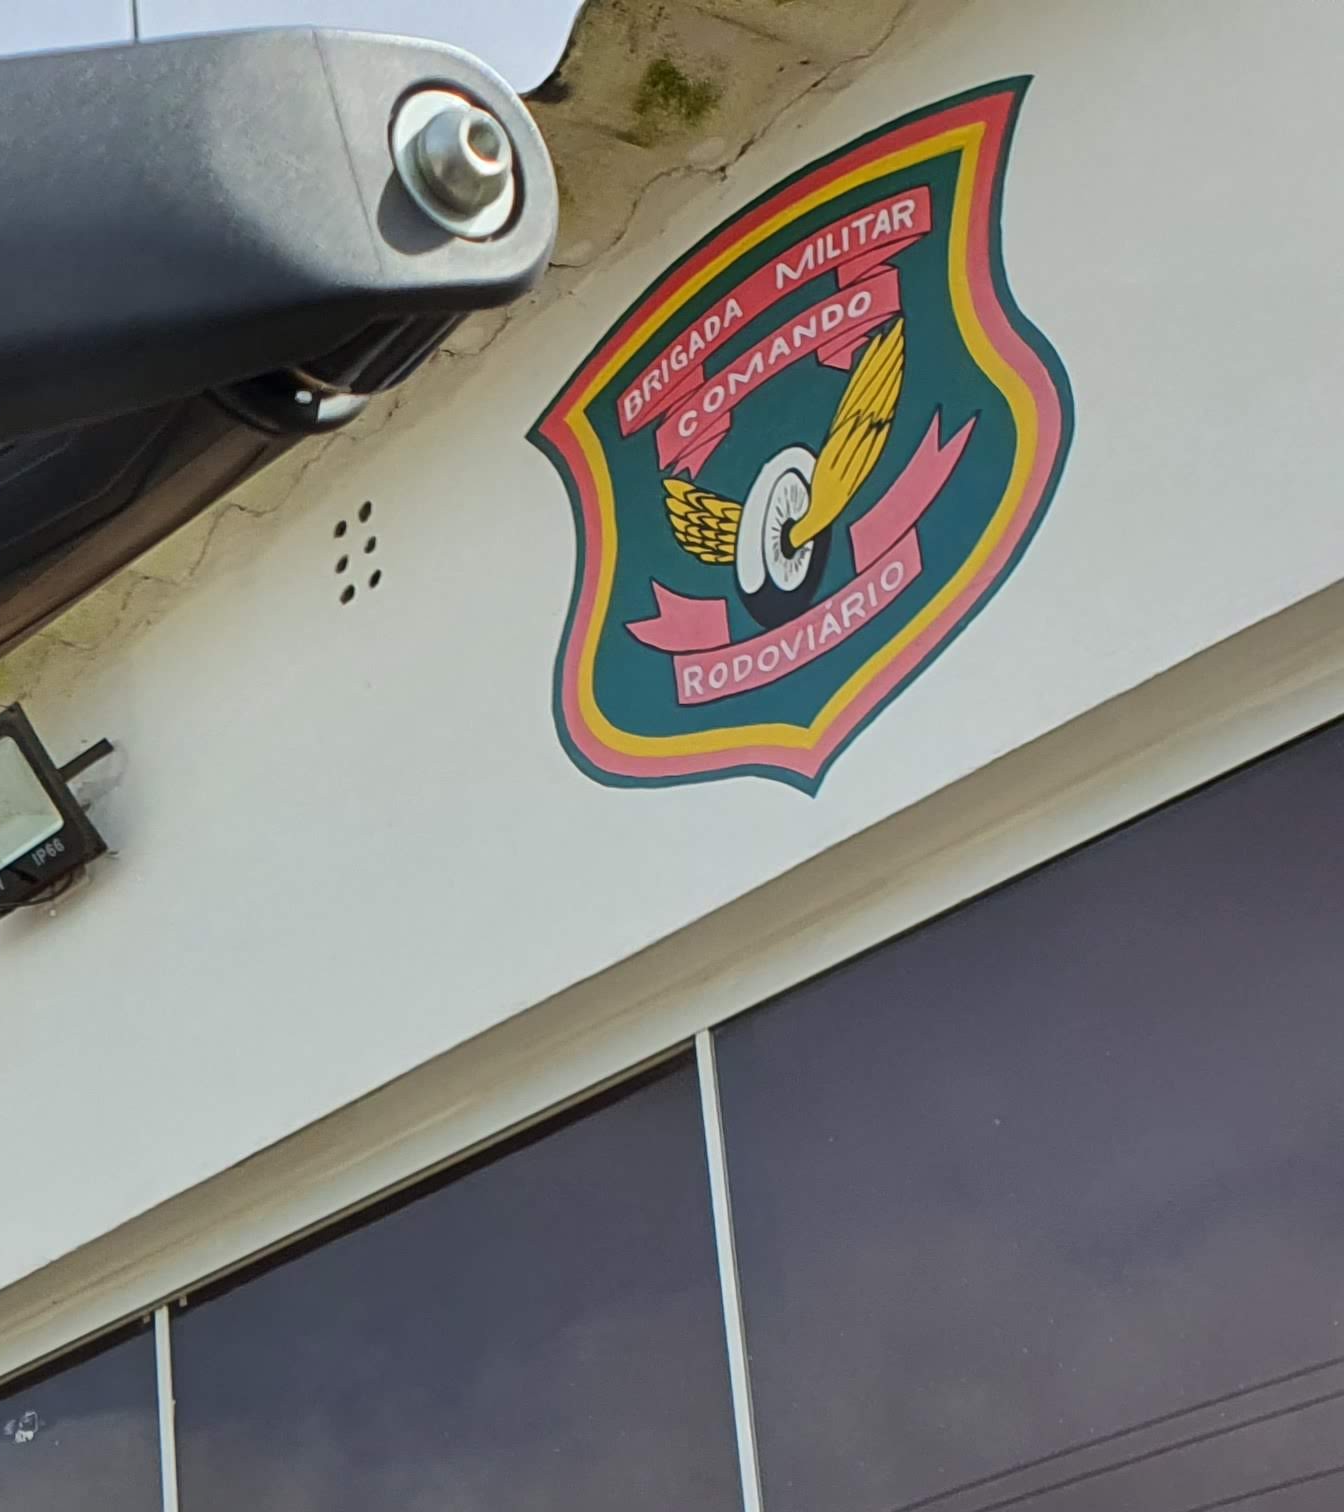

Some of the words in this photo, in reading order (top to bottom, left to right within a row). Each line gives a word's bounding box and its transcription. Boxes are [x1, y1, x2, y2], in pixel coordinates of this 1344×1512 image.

[623, 298, 744, 421] BRIGADA
[774, 199, 916, 290] MILITAR
[678, 290, 873, 438] COMANDO
[682, 560, 906, 700] RODOVIÁRIO
[31, 838, 65, 867] IP66
